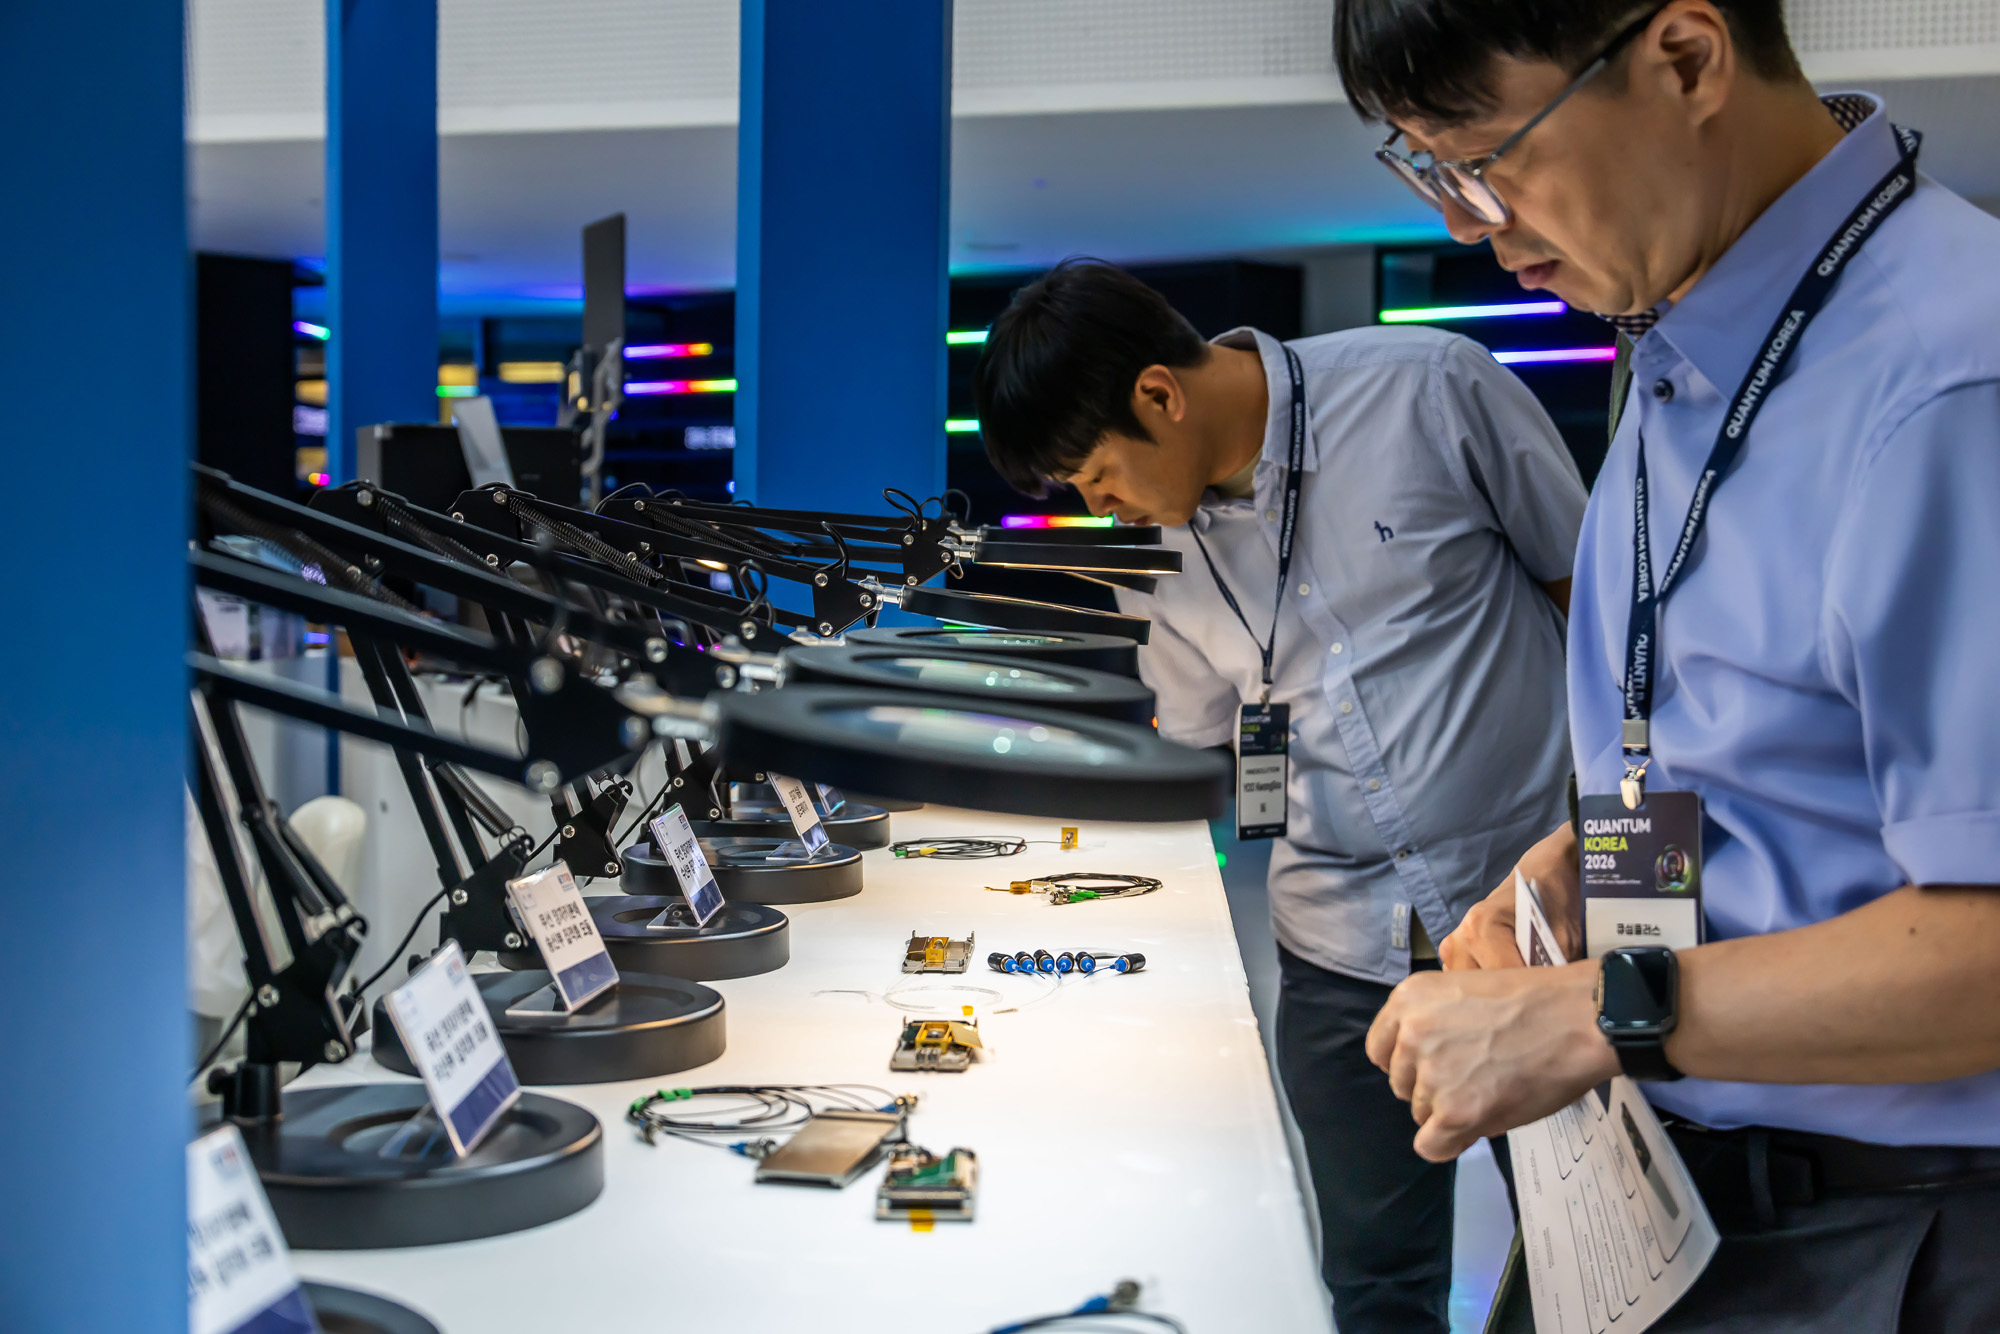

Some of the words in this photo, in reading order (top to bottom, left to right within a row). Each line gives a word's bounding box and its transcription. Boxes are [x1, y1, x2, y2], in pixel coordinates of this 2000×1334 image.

[1817, 207, 1879, 276] QUANTUM
[1726, 360, 1775, 439] QUANTUM
[1765, 309, 1805, 363] KOREA
[1636, 477, 1647, 551] QUANTUM
[1690, 469, 1717, 520] KOREA
[1637, 551, 1650, 603] KOREA
[1584, 818, 1651, 835] QUANTUM
[1584, 836, 1628, 851] KOREA
[1585, 854, 1616, 869] 2026
